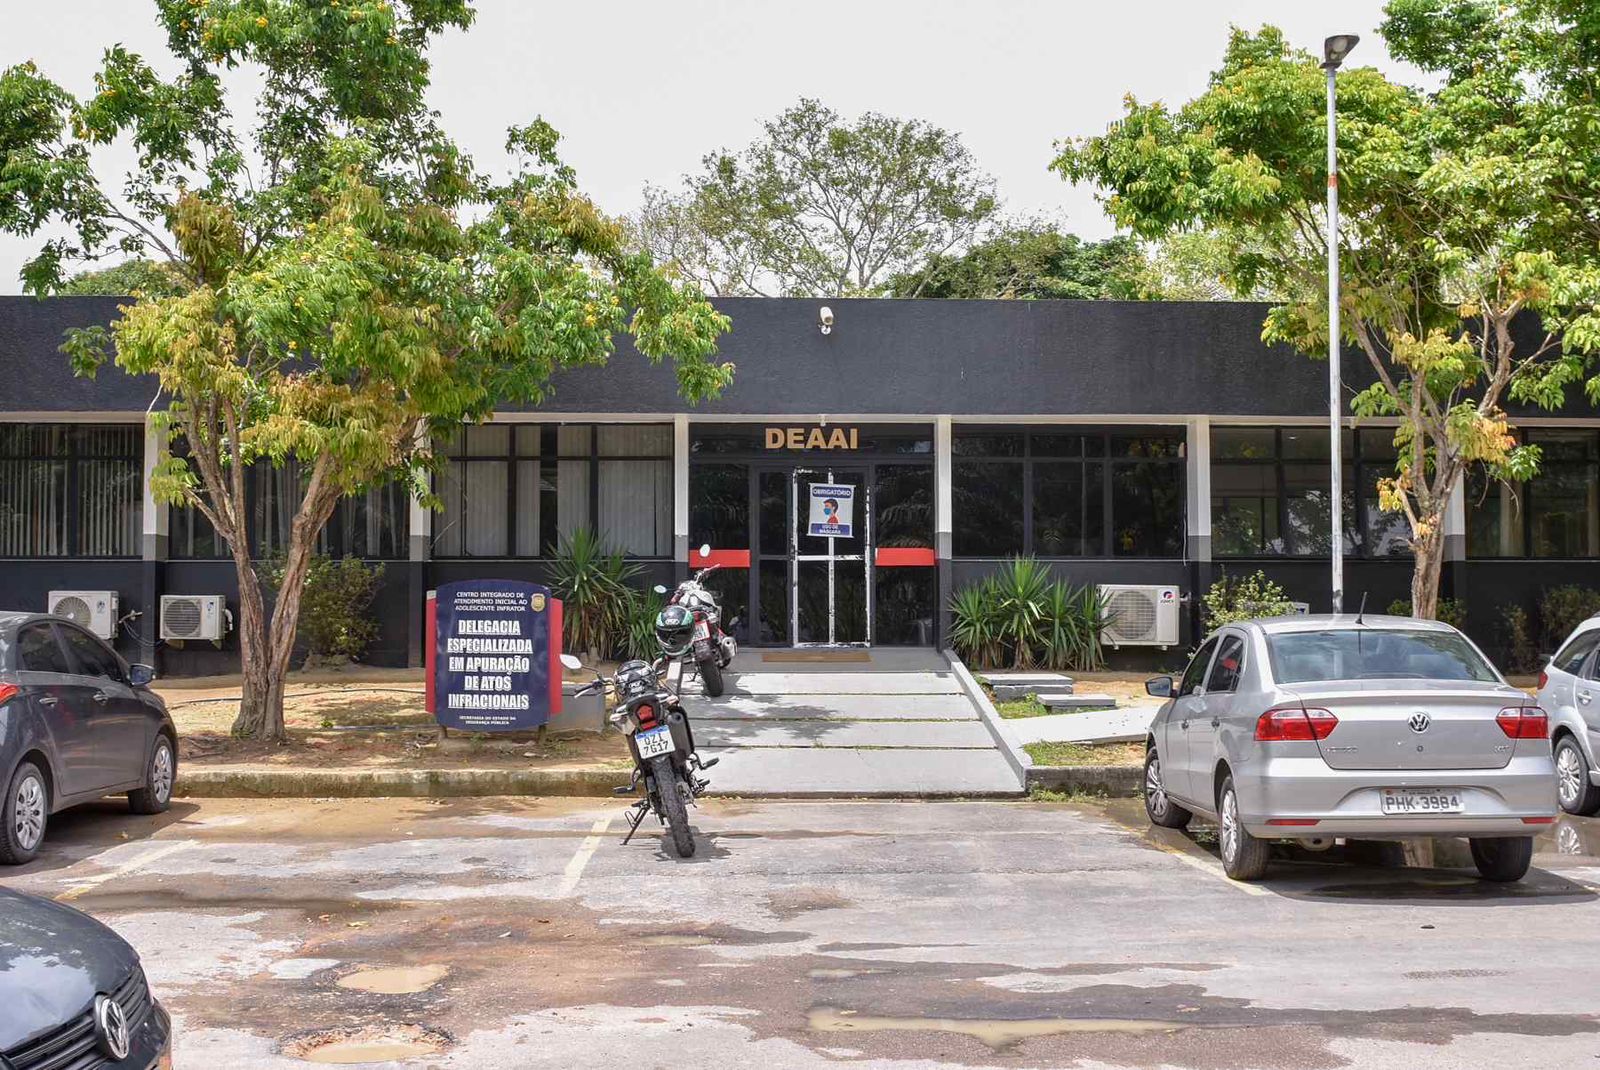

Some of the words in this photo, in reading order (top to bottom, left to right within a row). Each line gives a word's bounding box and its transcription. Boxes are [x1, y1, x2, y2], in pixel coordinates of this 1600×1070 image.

[765, 428, 858, 449] DEAAI
[458, 620, 521, 635] DELEGACIA
[447, 638, 533, 654] ESPECIALIZADA
[448, 657, 464, 671] EM
[466, 655, 530, 675] APURAÇÃO
[464, 676, 478, 690] DE
[480, 676, 512, 691] ATOS
[448, 694, 530, 710] INFRACIONAIS
